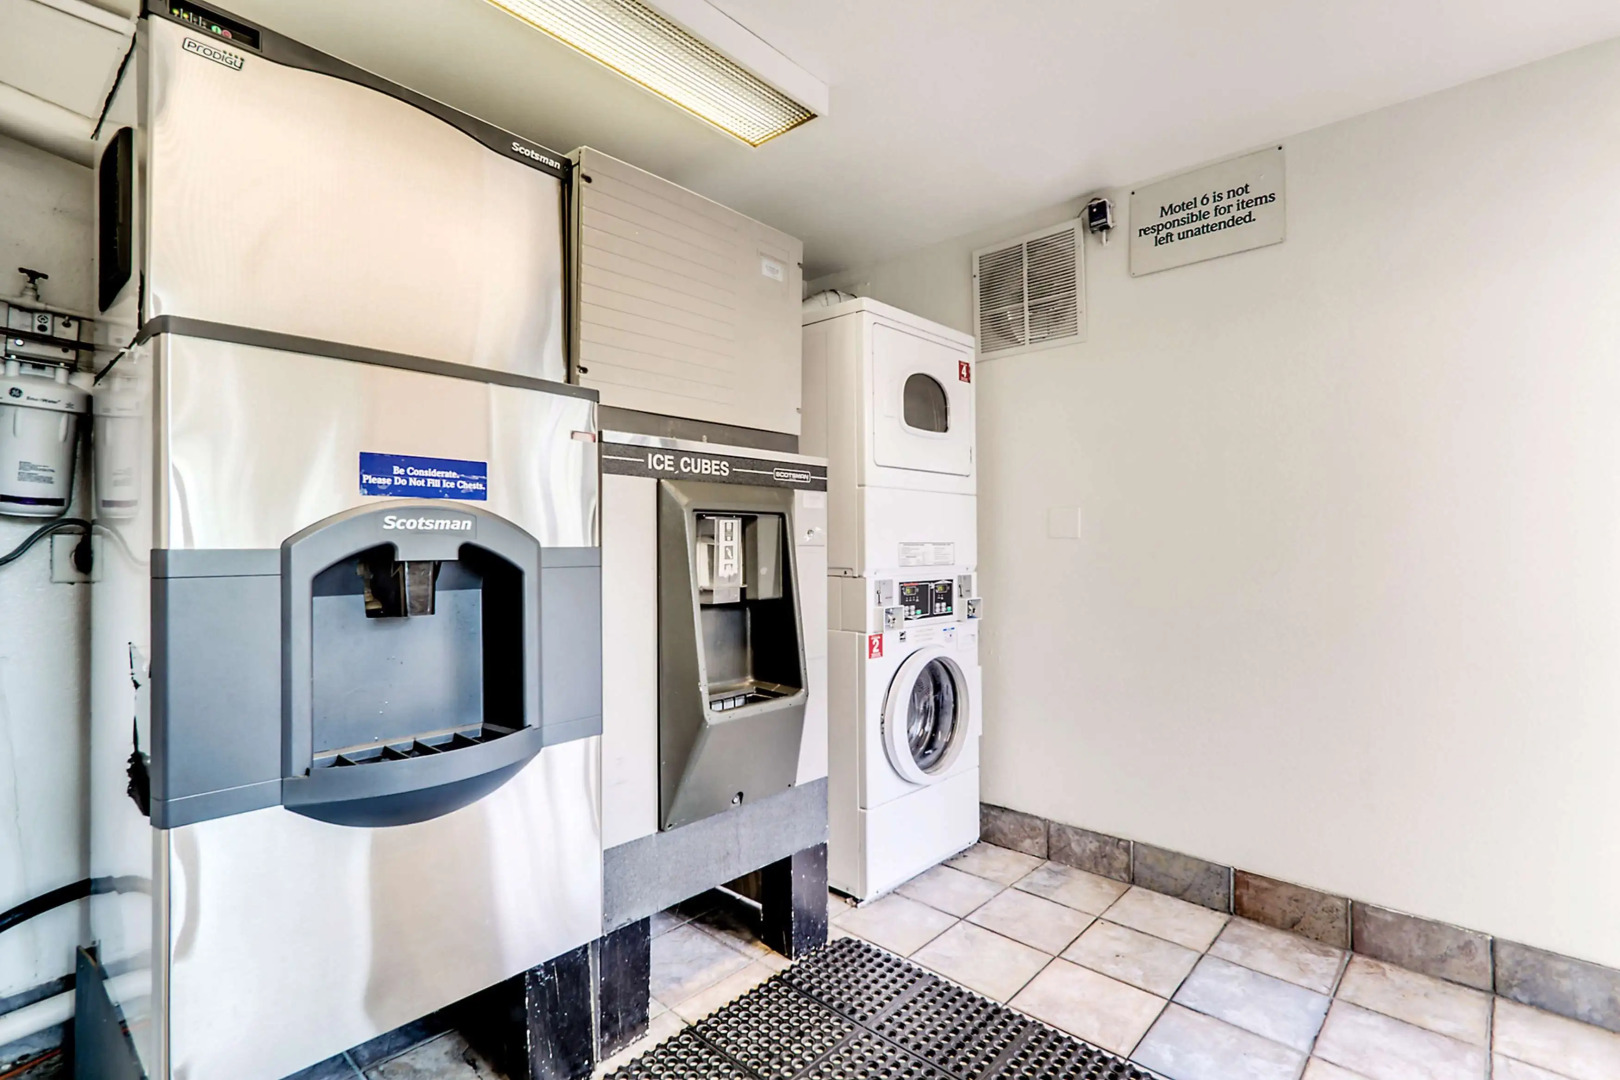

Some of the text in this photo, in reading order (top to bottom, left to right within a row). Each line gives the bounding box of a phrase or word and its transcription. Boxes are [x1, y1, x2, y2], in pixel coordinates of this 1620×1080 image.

[511, 141, 561, 170] Scotsman
[1159, 183, 1250, 218] Motel 6 is not
[1138, 192, 1276, 238] responsible for items
[1154, 210, 1256, 247] left unattended.
[961, 365, 967, 378] 4
[392, 465, 460, 479] Be Considerate.
[648, 453, 730, 477] ICE CUBES
[362, 474, 486, 491] Please Do Not Fill Ice Chests.
[382, 515, 472, 531] Scotsman
[872, 637, 880, 653] 2
